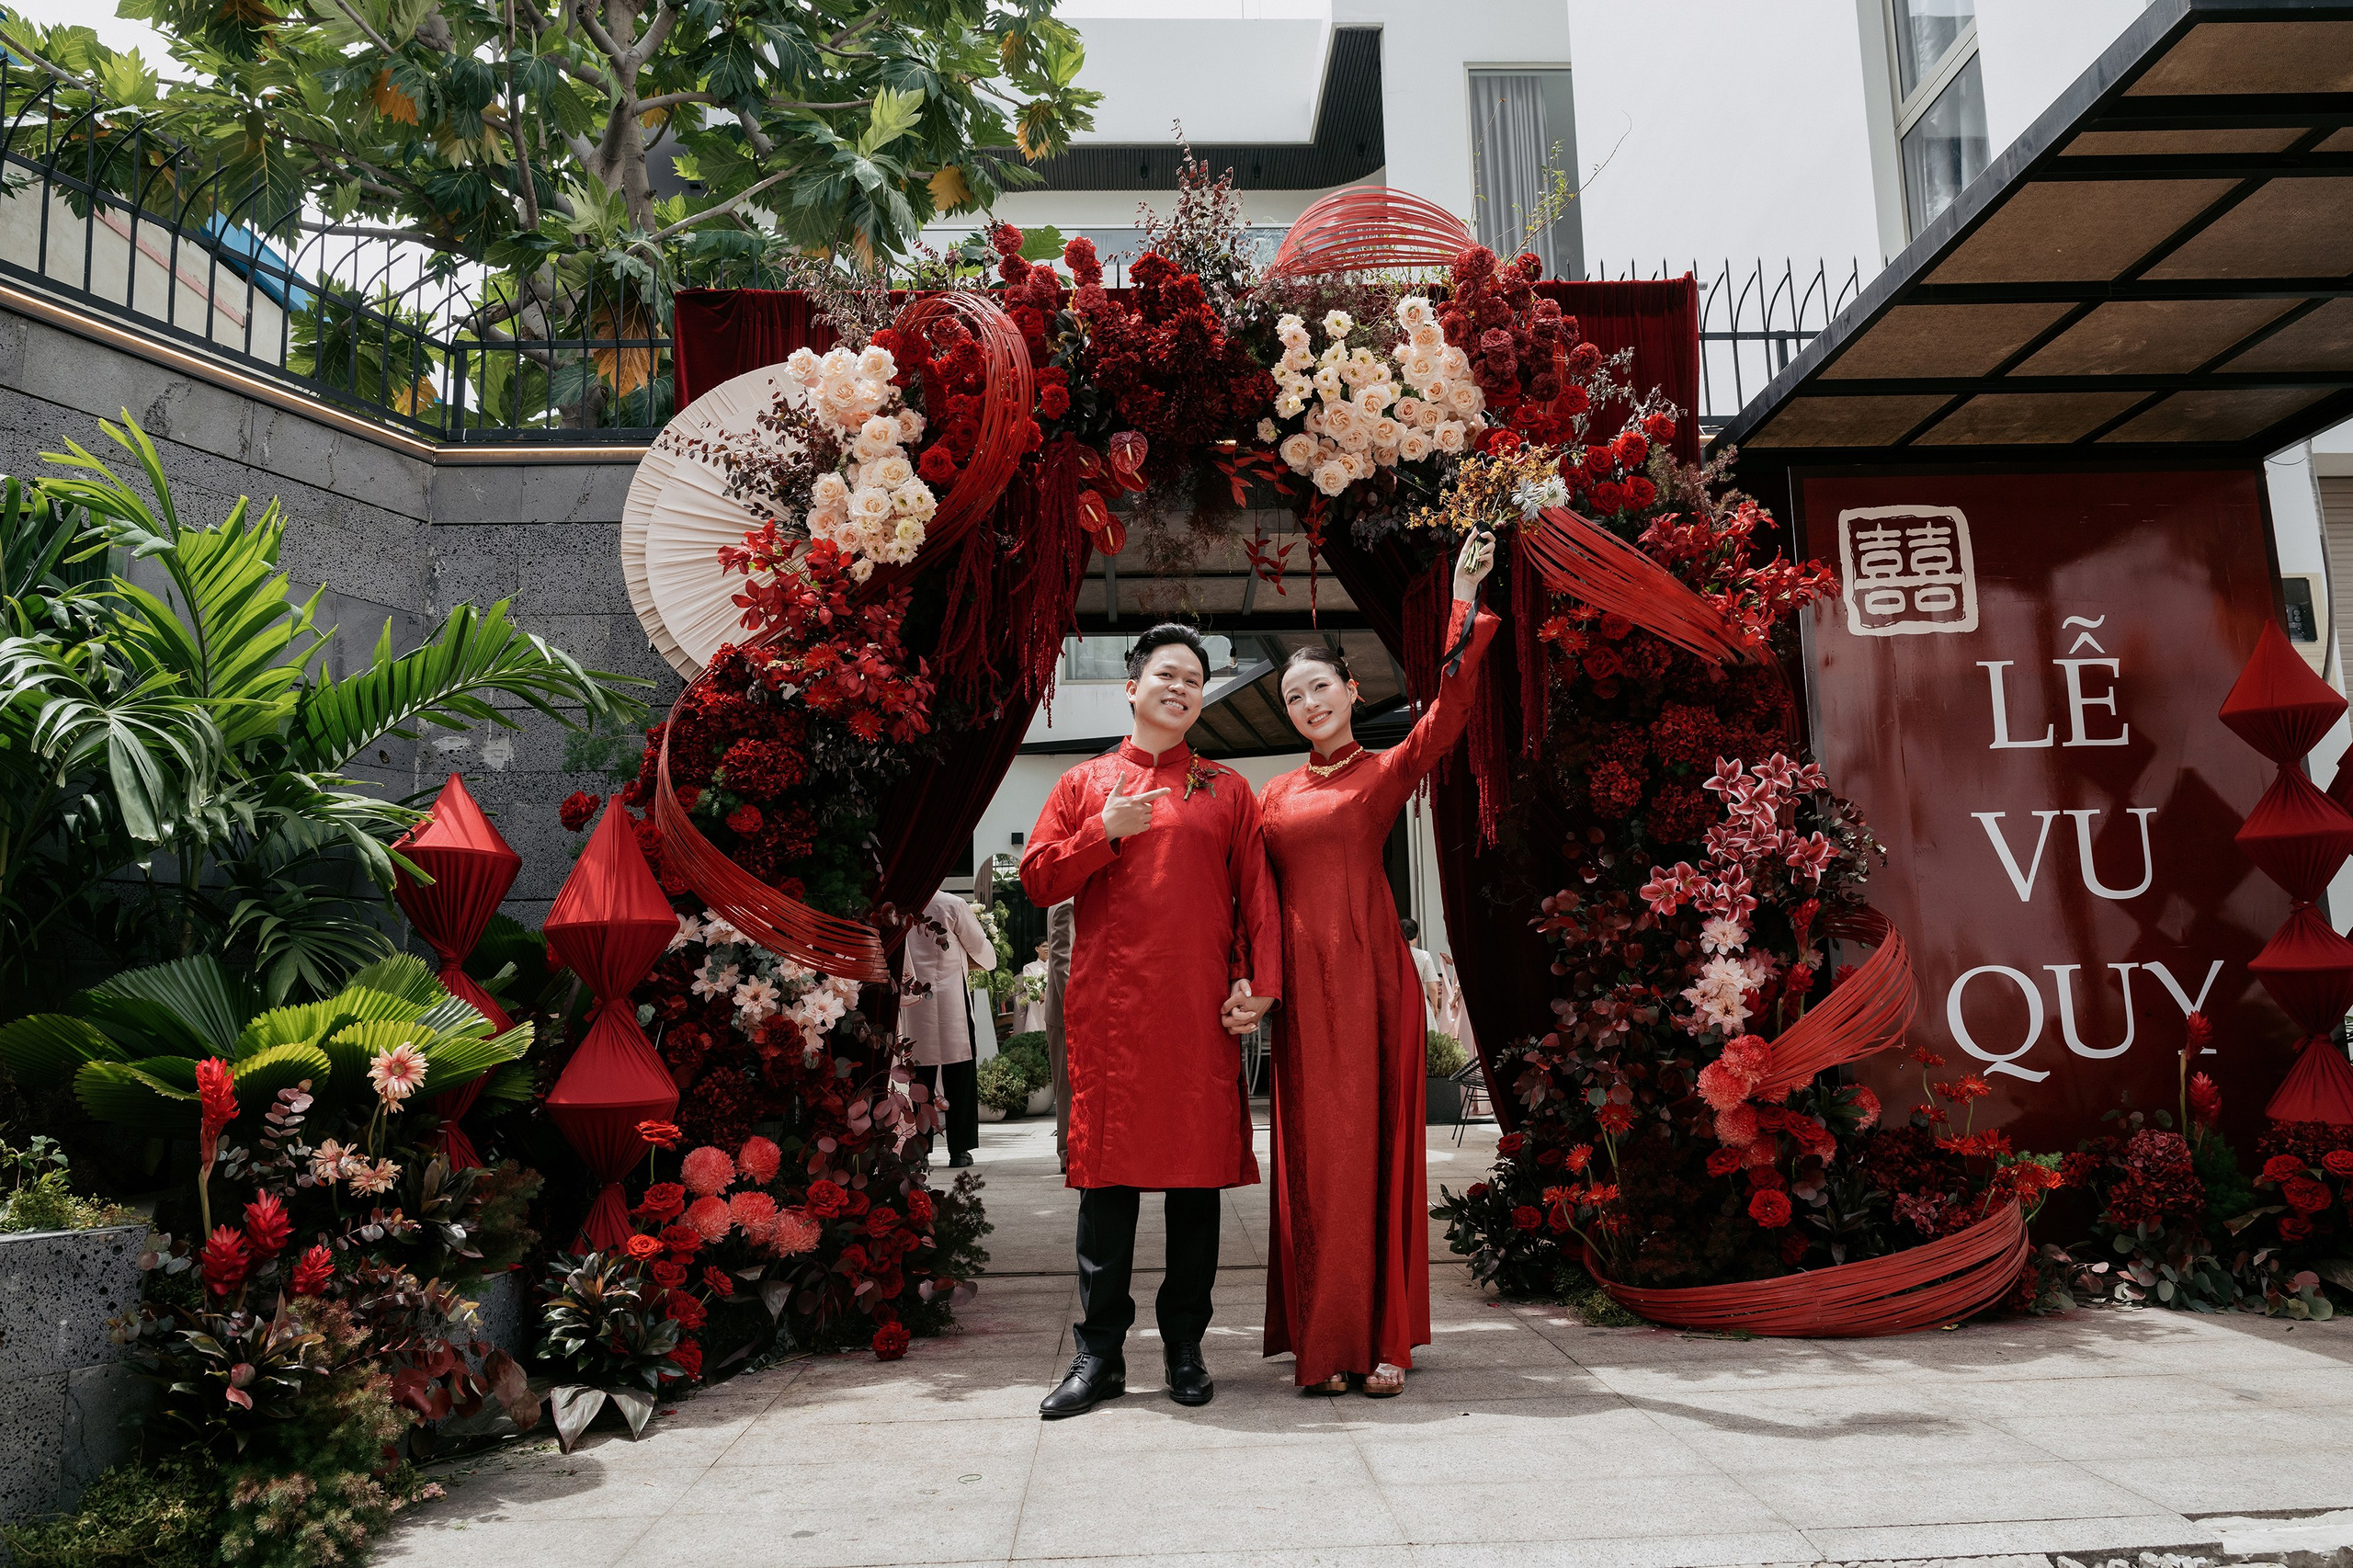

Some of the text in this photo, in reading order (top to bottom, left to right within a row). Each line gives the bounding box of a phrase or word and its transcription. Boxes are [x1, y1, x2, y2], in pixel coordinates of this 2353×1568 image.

[1975, 614, 2130, 750] LỄ
[1970, 807, 2158, 903] VU
[1946, 960, 2224, 1084] QUY
